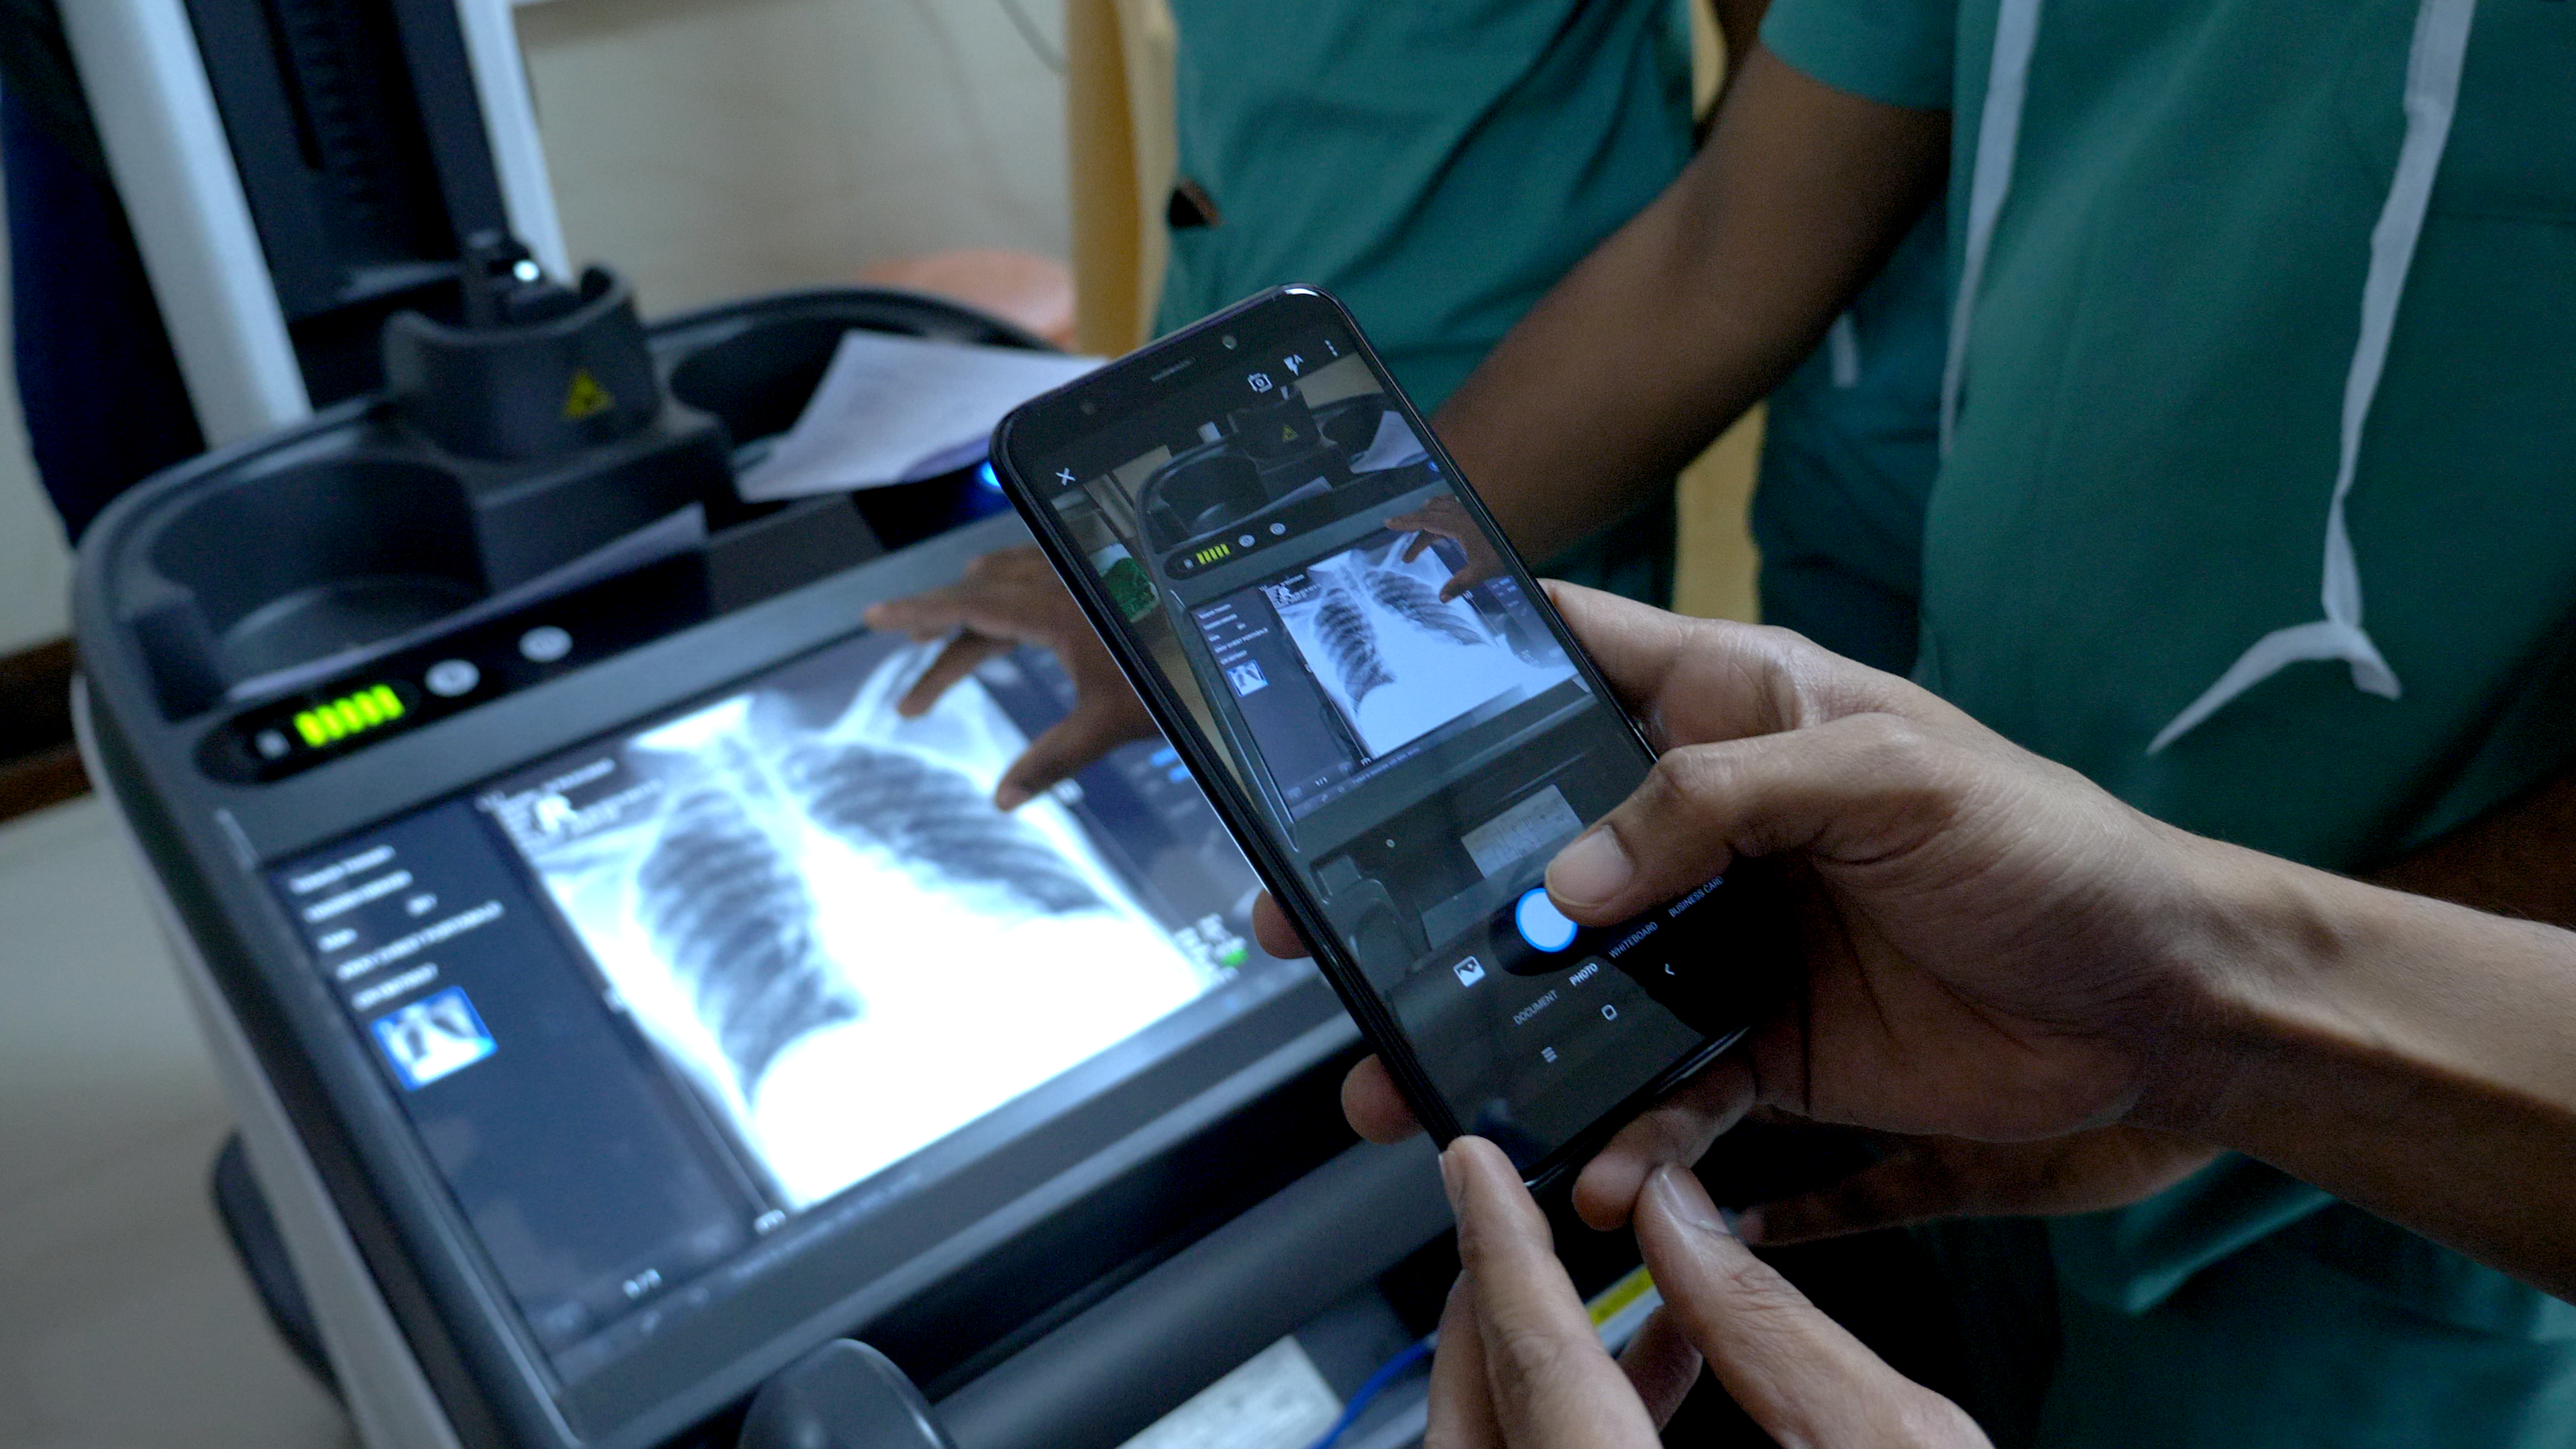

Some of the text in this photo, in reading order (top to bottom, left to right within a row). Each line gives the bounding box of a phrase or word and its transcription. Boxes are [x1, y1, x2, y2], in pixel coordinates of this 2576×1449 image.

[1513, 875, 1724, 1025] DOCUMENT PHOTO WHITEBOARD BUSINESS CARD
